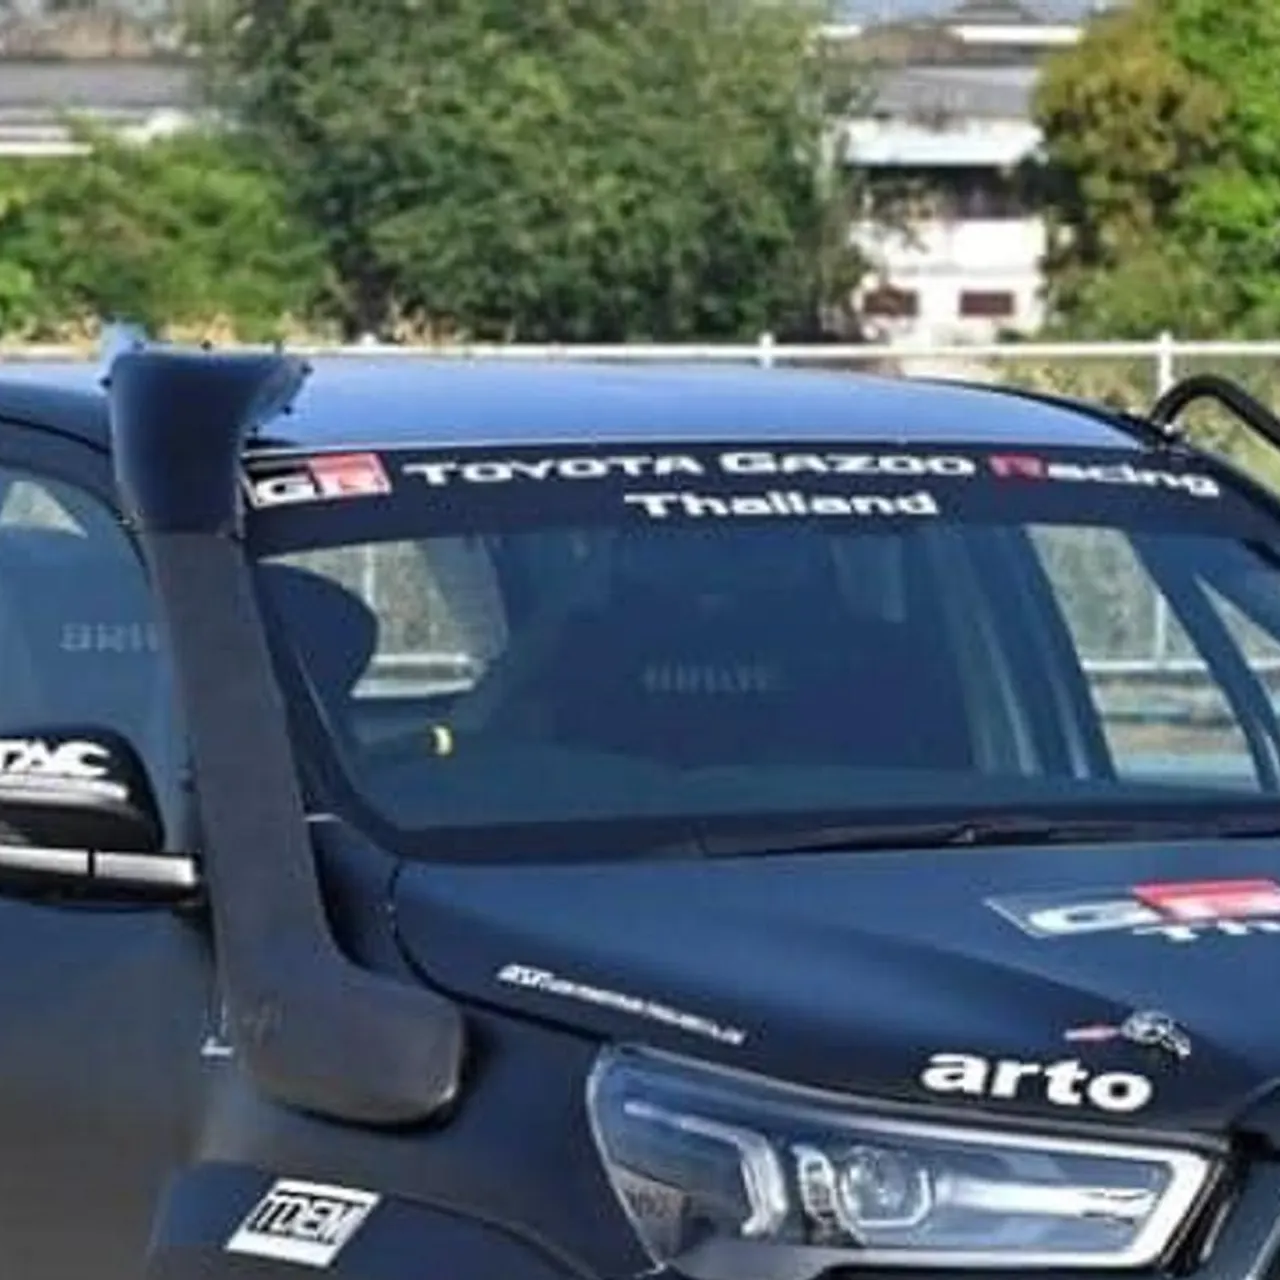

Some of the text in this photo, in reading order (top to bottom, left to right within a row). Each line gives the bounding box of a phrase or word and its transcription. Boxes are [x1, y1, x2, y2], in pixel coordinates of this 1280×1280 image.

[402, 452, 1222, 498] TOYOTA GAZOO Racing
[624, 490, 939, 517] Thailand
[921, 1053, 1153, 1112] arto
